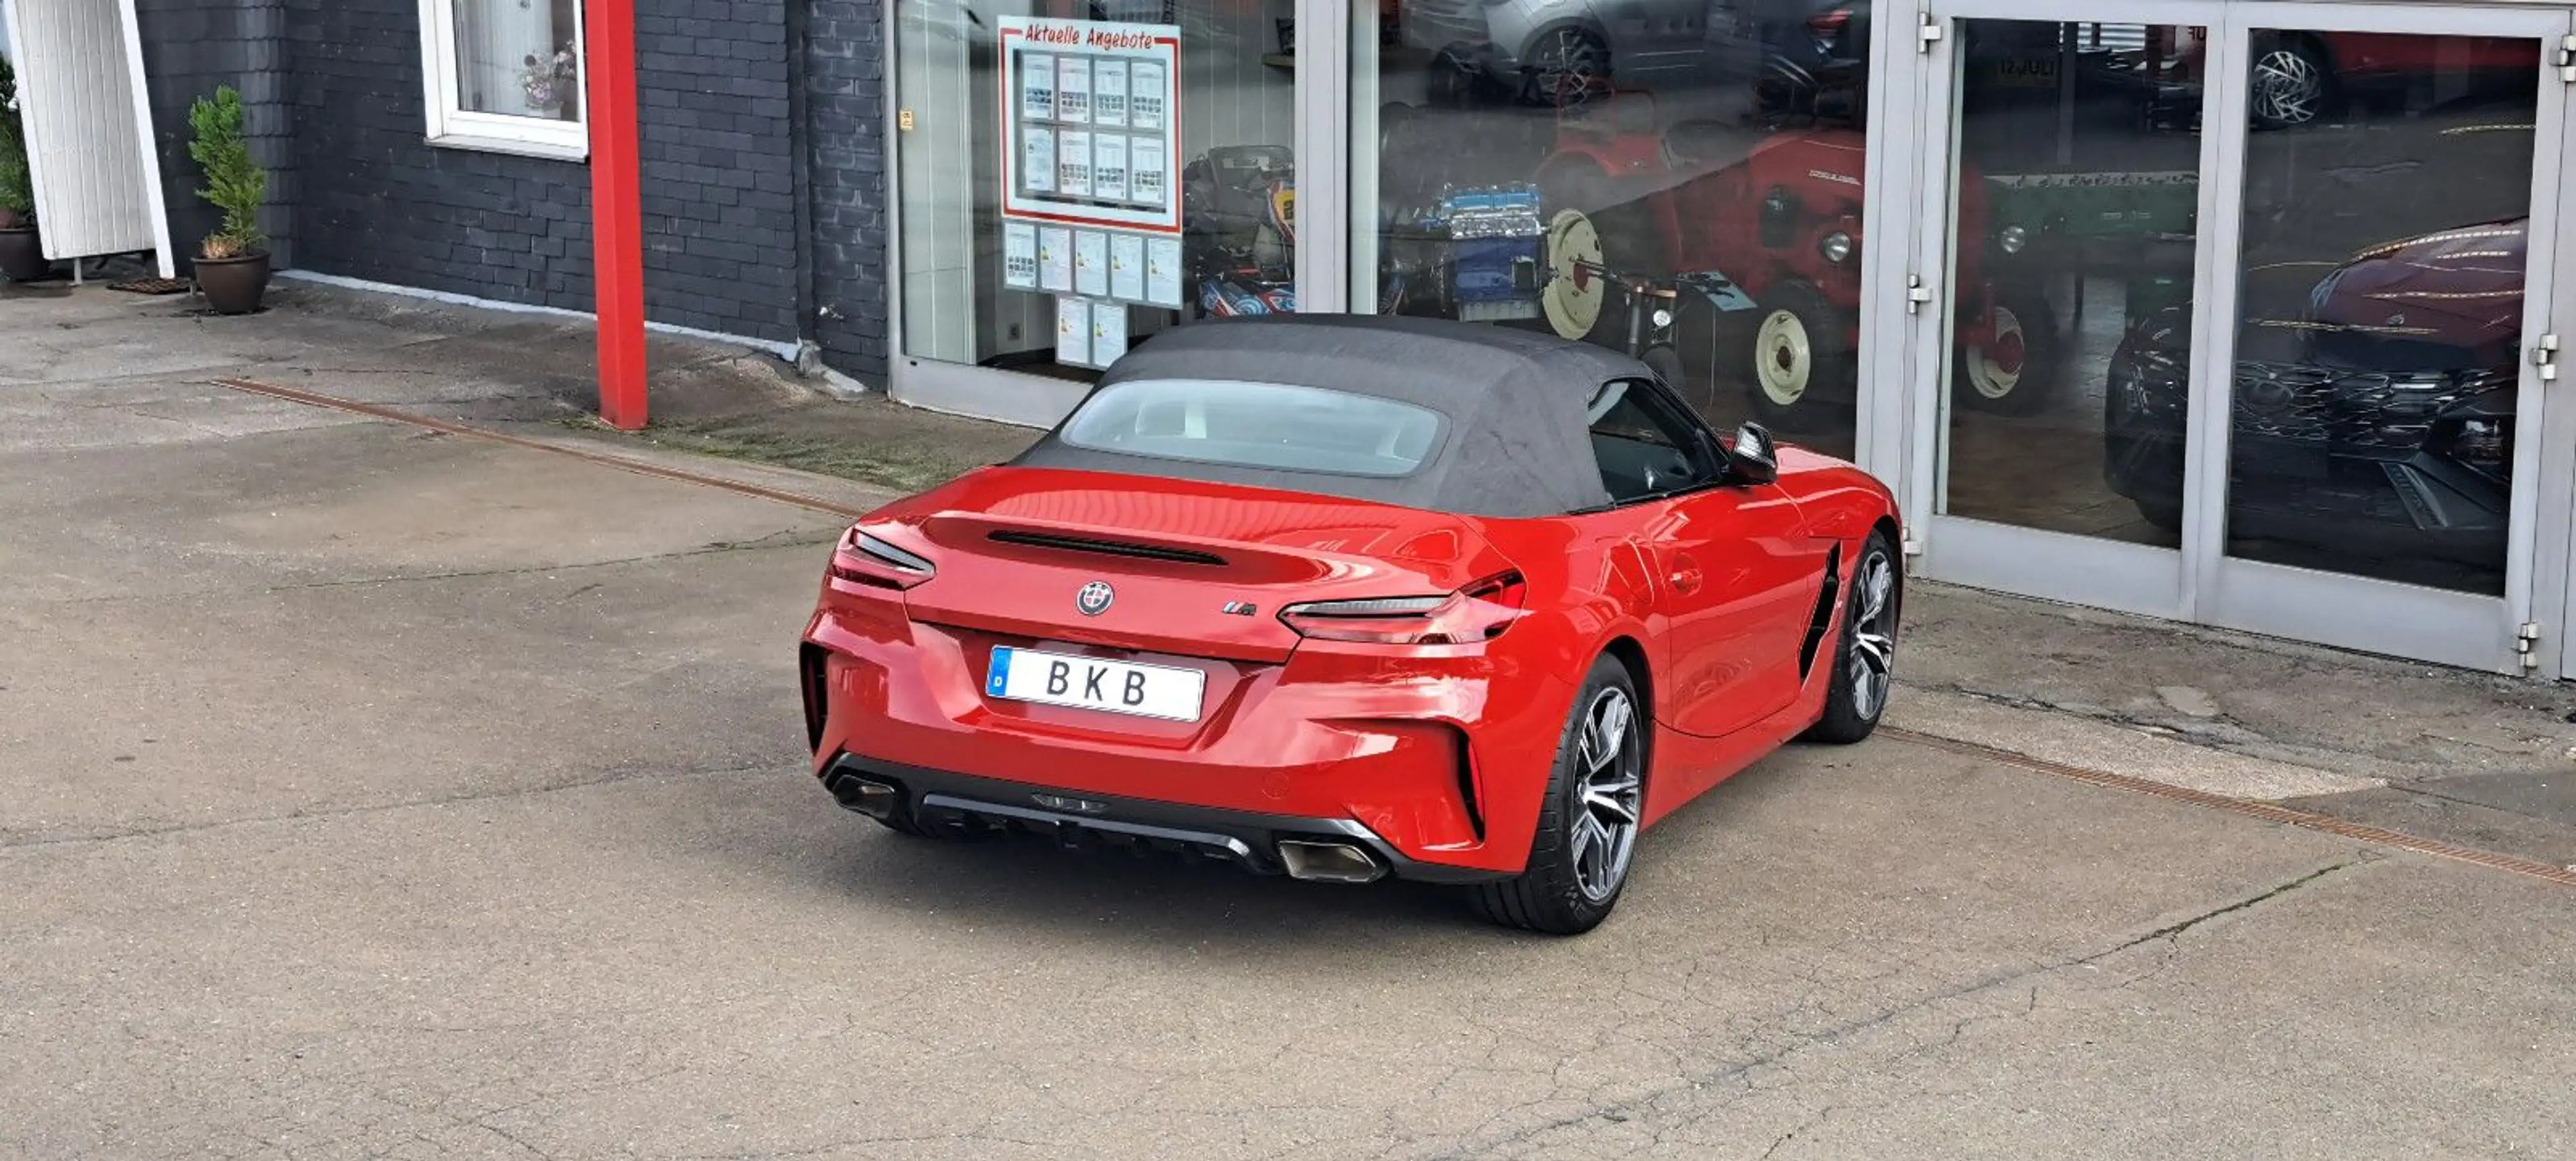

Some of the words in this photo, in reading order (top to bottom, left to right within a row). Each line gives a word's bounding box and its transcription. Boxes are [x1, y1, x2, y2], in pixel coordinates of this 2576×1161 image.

[1026, 24, 1079, 44] Aktuelle
[1087, 28, 1152, 50] Angebote
[994, 676, 1003, 687] D
